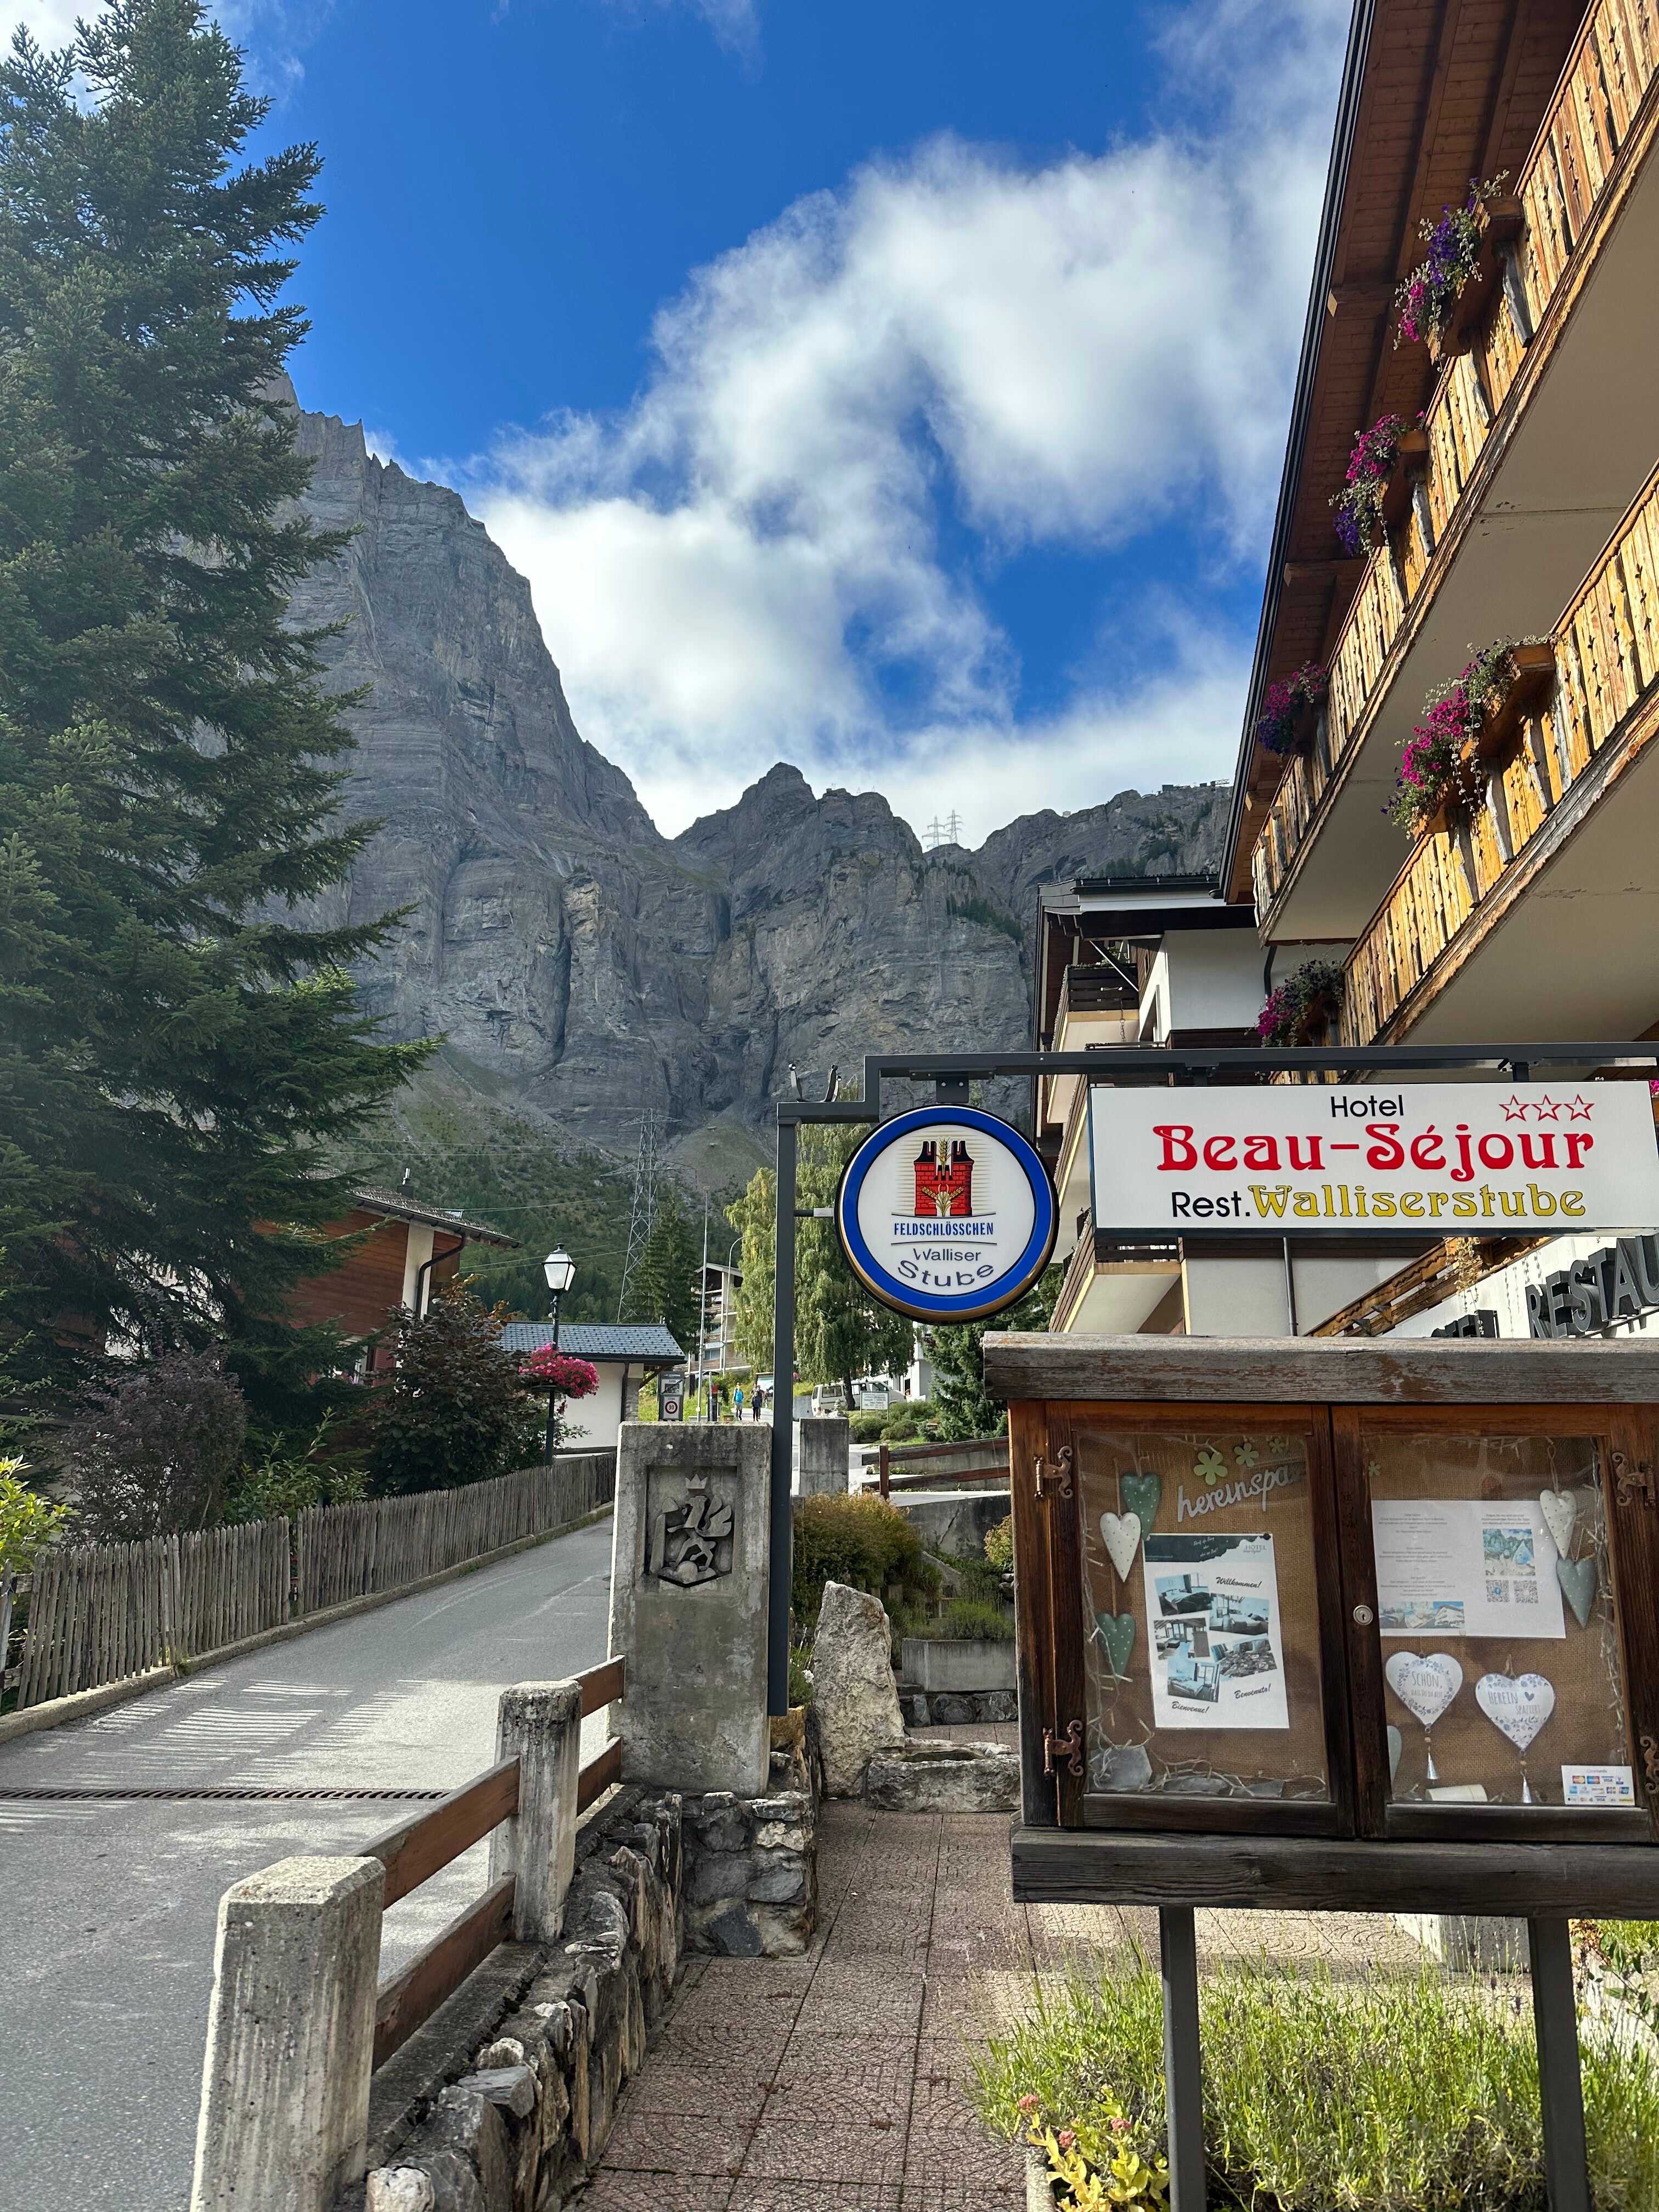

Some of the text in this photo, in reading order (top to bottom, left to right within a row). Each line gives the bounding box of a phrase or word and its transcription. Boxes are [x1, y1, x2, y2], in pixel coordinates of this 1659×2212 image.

[1330, 1095, 1405, 1118] Hotel
[1153, 1124, 1594, 1182] Beau-Séjour
[1171, 1184, 1585, 1217] Rest. Walliserstube
[894, 1221, 994, 1236] FELDSCHLÖSSCHEN
[913, 1248, 981, 1262] Walliser
[898, 1260, 995, 1286] Stube
[1216, 1576, 1262, 1588] Willkommen!
[1234, 1683, 1271, 1699] Benvenuto!
[1488, 1691, 1518, 1705] HEREIN
[1172, 1701, 1210, 1714] Bienvenue!
